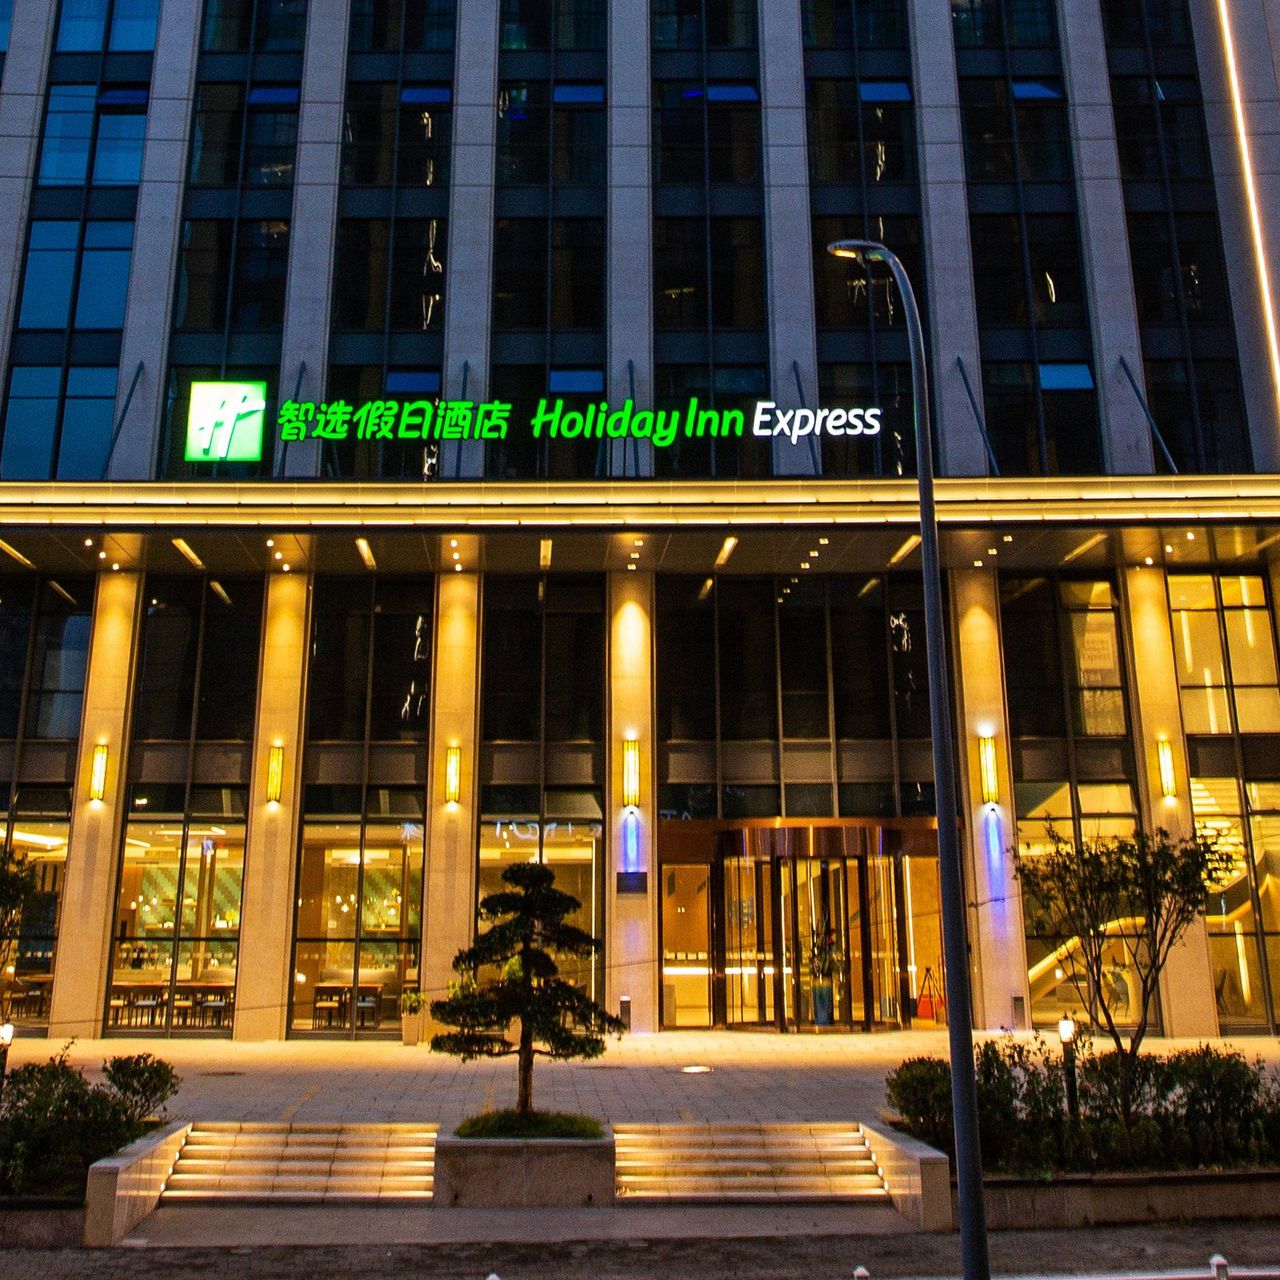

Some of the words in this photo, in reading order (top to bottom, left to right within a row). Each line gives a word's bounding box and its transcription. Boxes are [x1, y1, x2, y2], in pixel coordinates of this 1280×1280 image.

[278, 398, 513, 442] 智选假日酒店
[752, 401, 882, 446] Express
